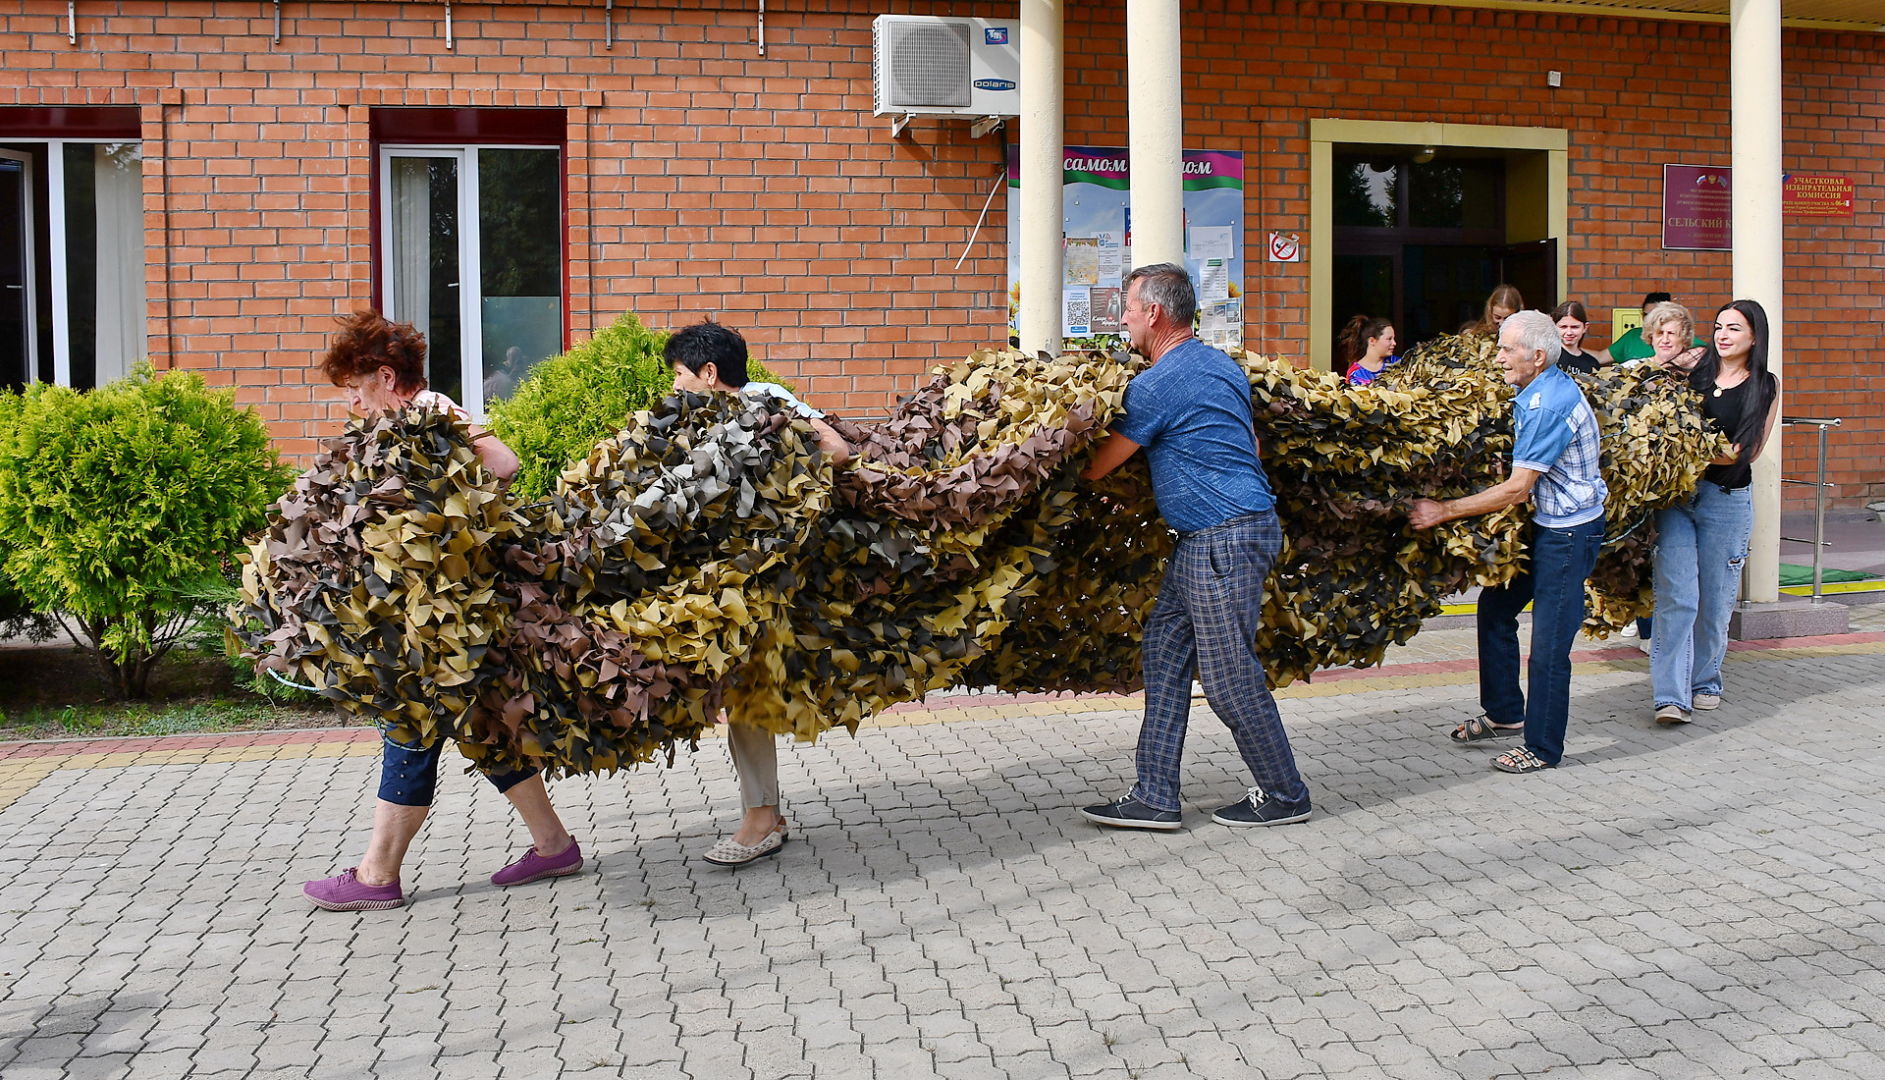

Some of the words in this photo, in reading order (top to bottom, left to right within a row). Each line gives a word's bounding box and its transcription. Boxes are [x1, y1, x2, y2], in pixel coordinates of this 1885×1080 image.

[974, 79, 1015, 88] polaris
[1063, 157, 1128, 173] самом
[1793, 177, 1845, 185] УЧАСТКОВАЯ
[1785, 184, 1852, 192] ИЗБИРАТЕЛЬНАЯ
[1797, 191, 1841, 199] КОМИССИЯ
[1668, 217, 1722, 228] СЕЛЬСКИЙ
